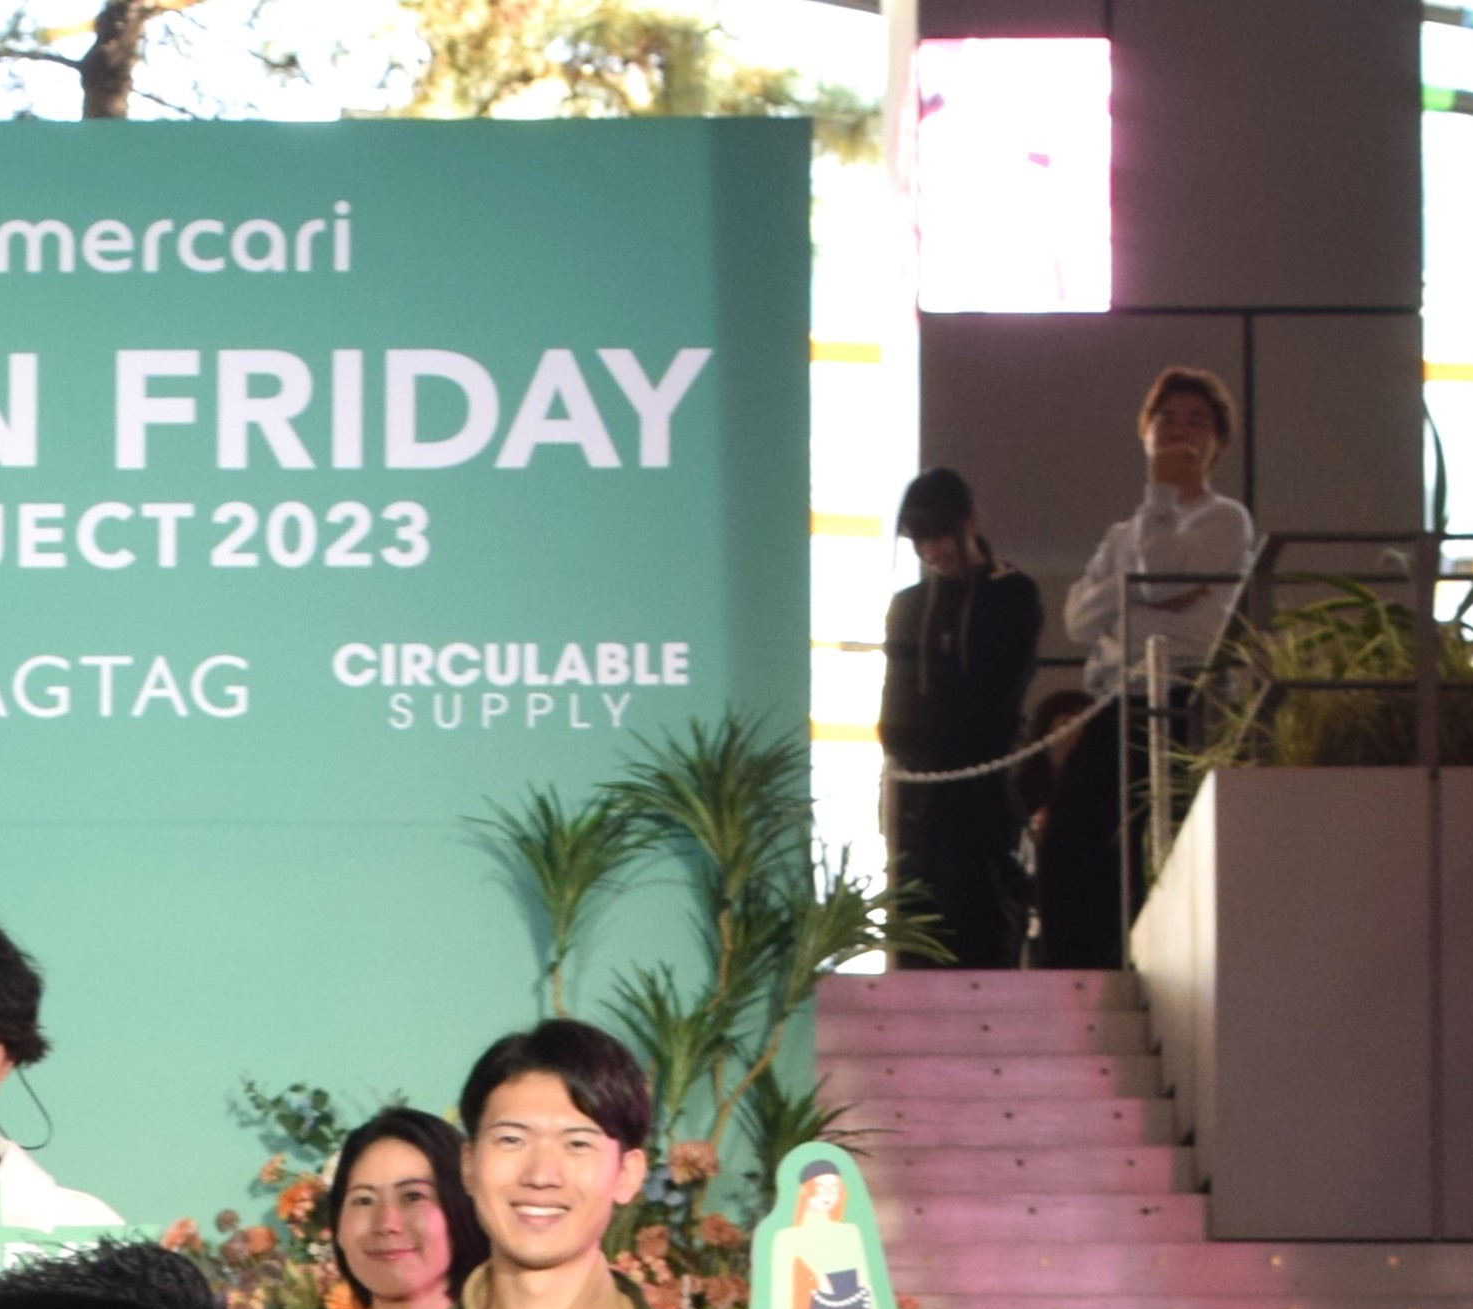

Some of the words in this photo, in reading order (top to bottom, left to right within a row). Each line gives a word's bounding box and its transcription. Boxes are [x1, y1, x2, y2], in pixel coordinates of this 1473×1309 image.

[115, 346, 712, 470] FRIDAY
[210, 500, 429, 568] 2023
[333, 641, 689, 686] CIRCULABLE
[387, 690, 632, 731] SUPPLY
